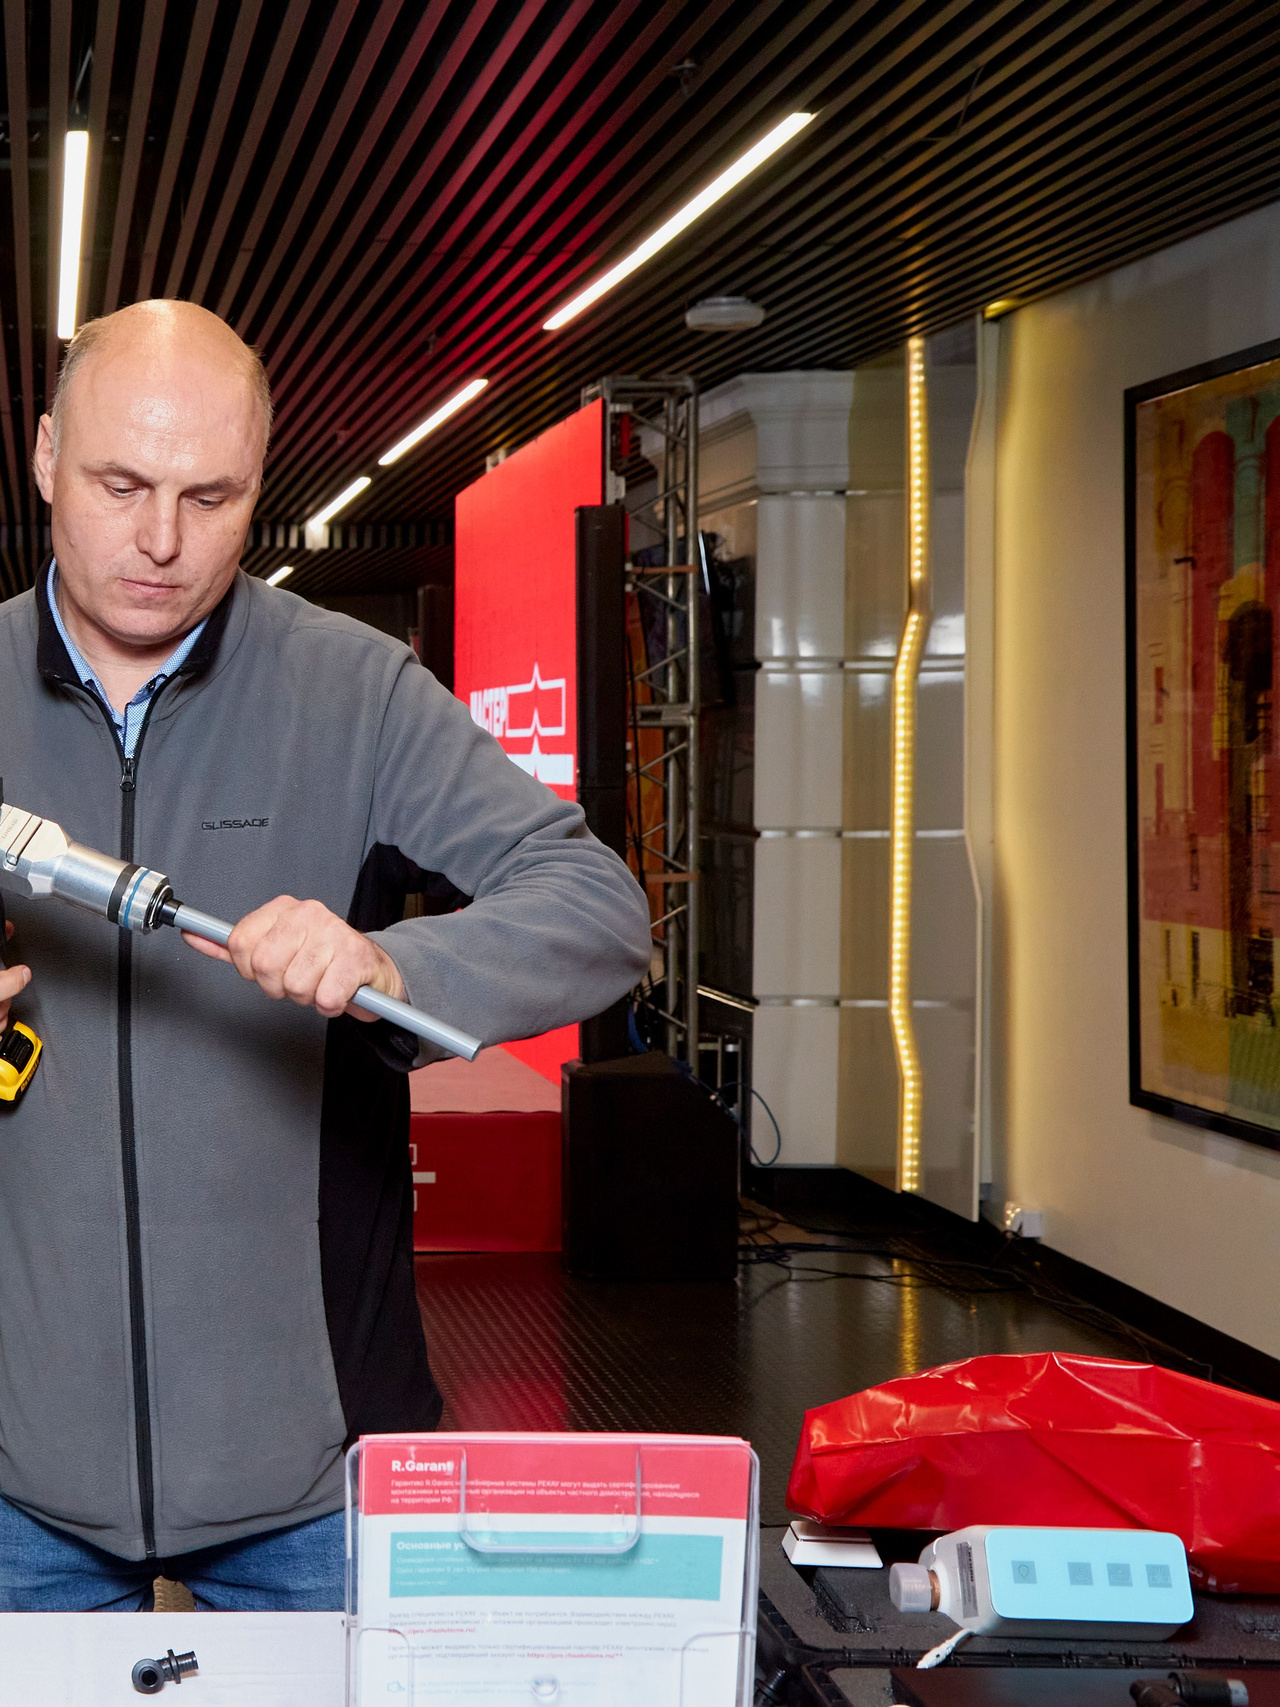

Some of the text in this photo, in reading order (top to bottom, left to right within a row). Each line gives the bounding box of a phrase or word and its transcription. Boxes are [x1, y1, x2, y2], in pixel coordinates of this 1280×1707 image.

[201, 817, 270, 831] GLISSADE
[391, 1459, 454, 1472] R.Garant
[466, 1479, 505, 1488] нженерные
[397, 1541, 451, 1551] Основные
